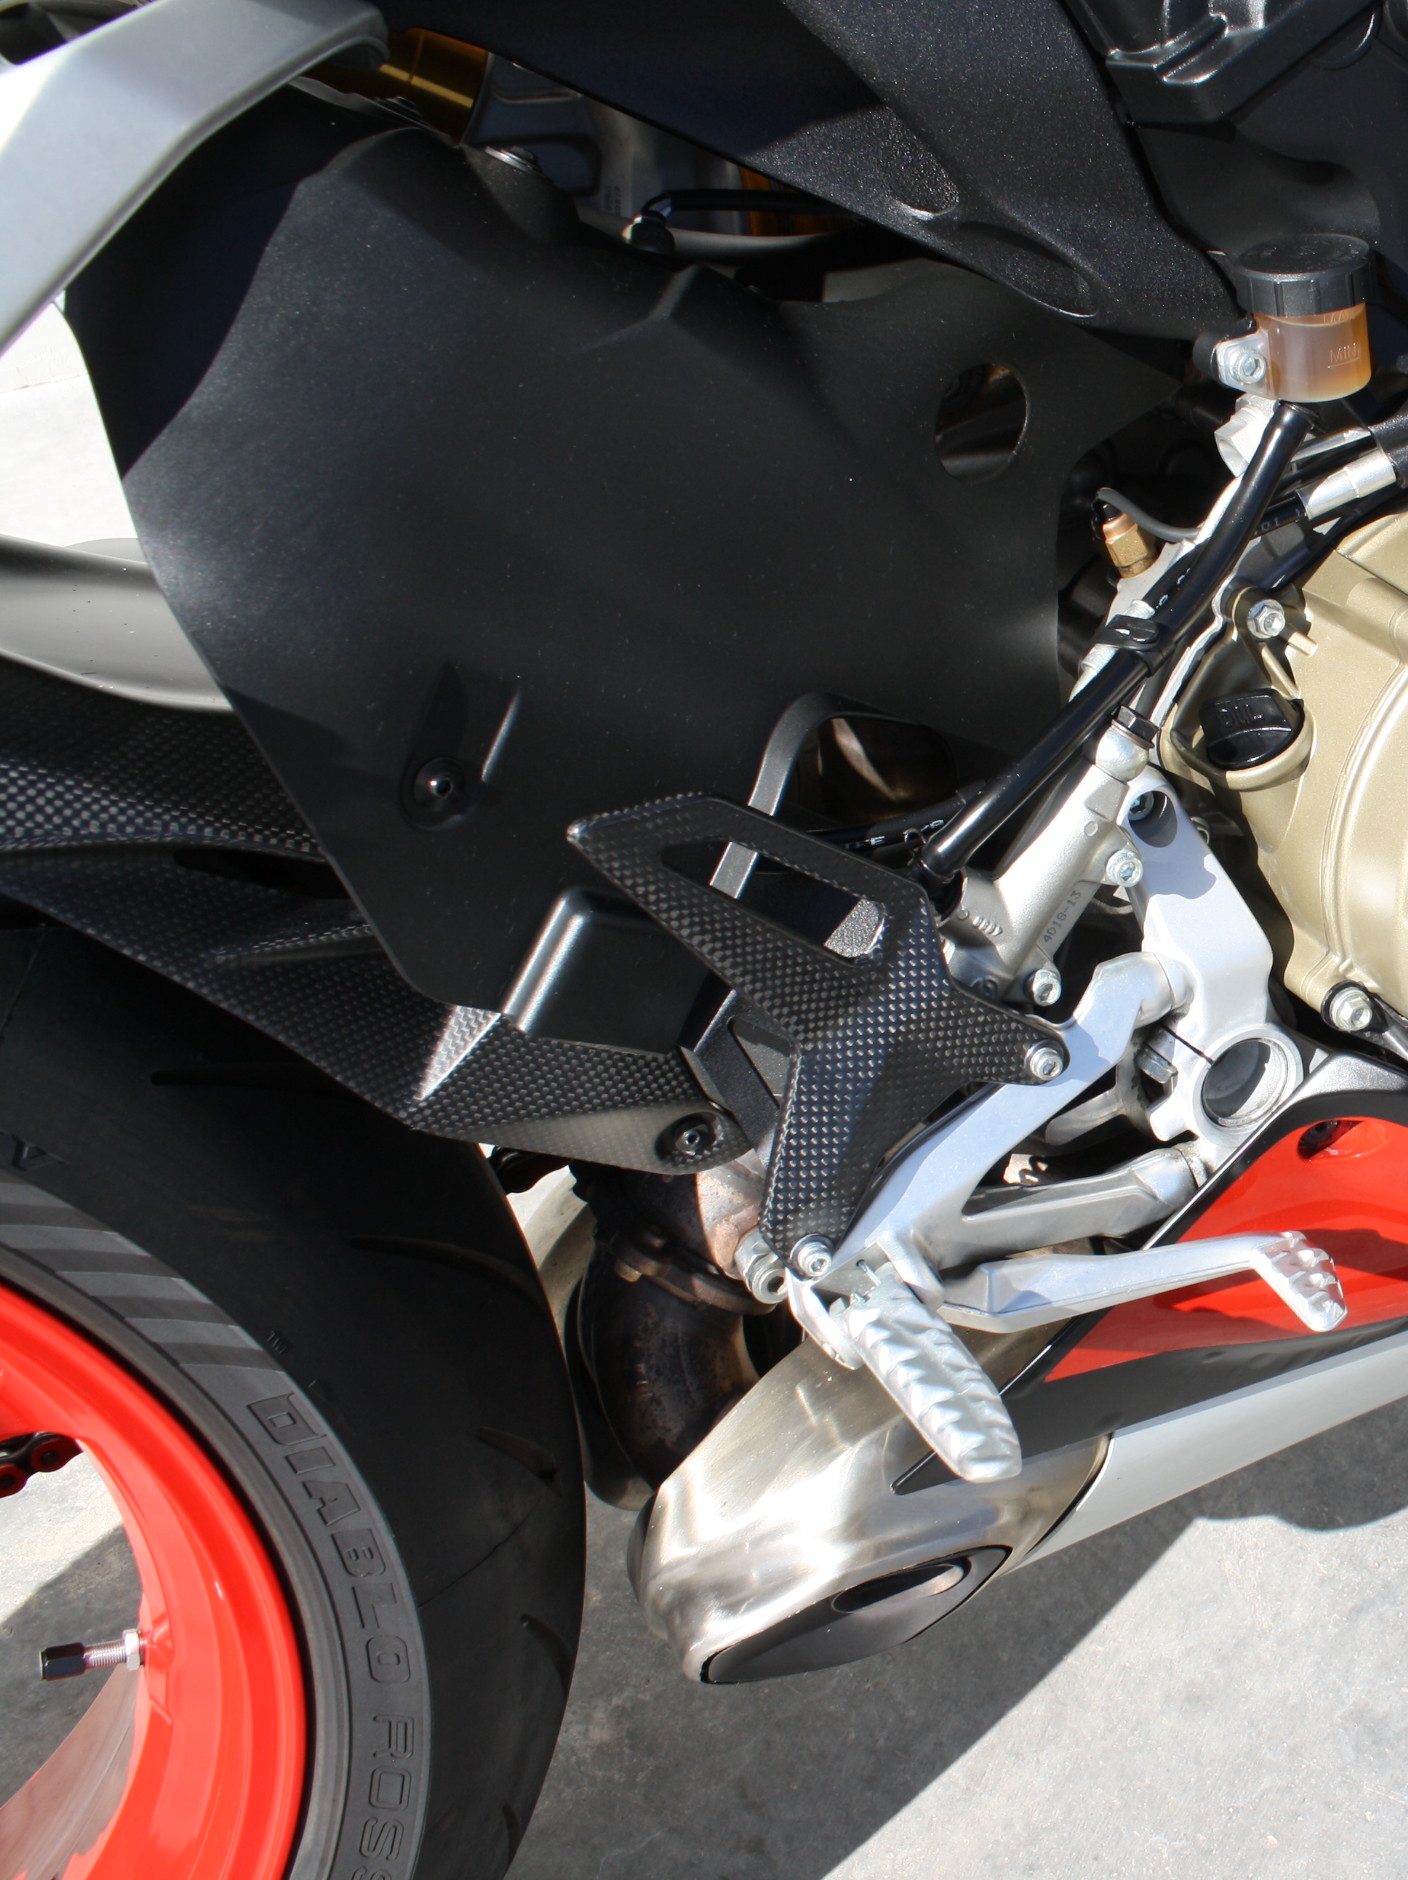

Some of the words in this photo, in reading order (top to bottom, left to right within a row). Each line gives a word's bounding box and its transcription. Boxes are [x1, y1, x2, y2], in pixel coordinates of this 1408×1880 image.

[1330, 342, 1360, 363] MIN
[1217, 703, 1264, 728] OIL
[246, 1391, 412, 1684] DIABLO
